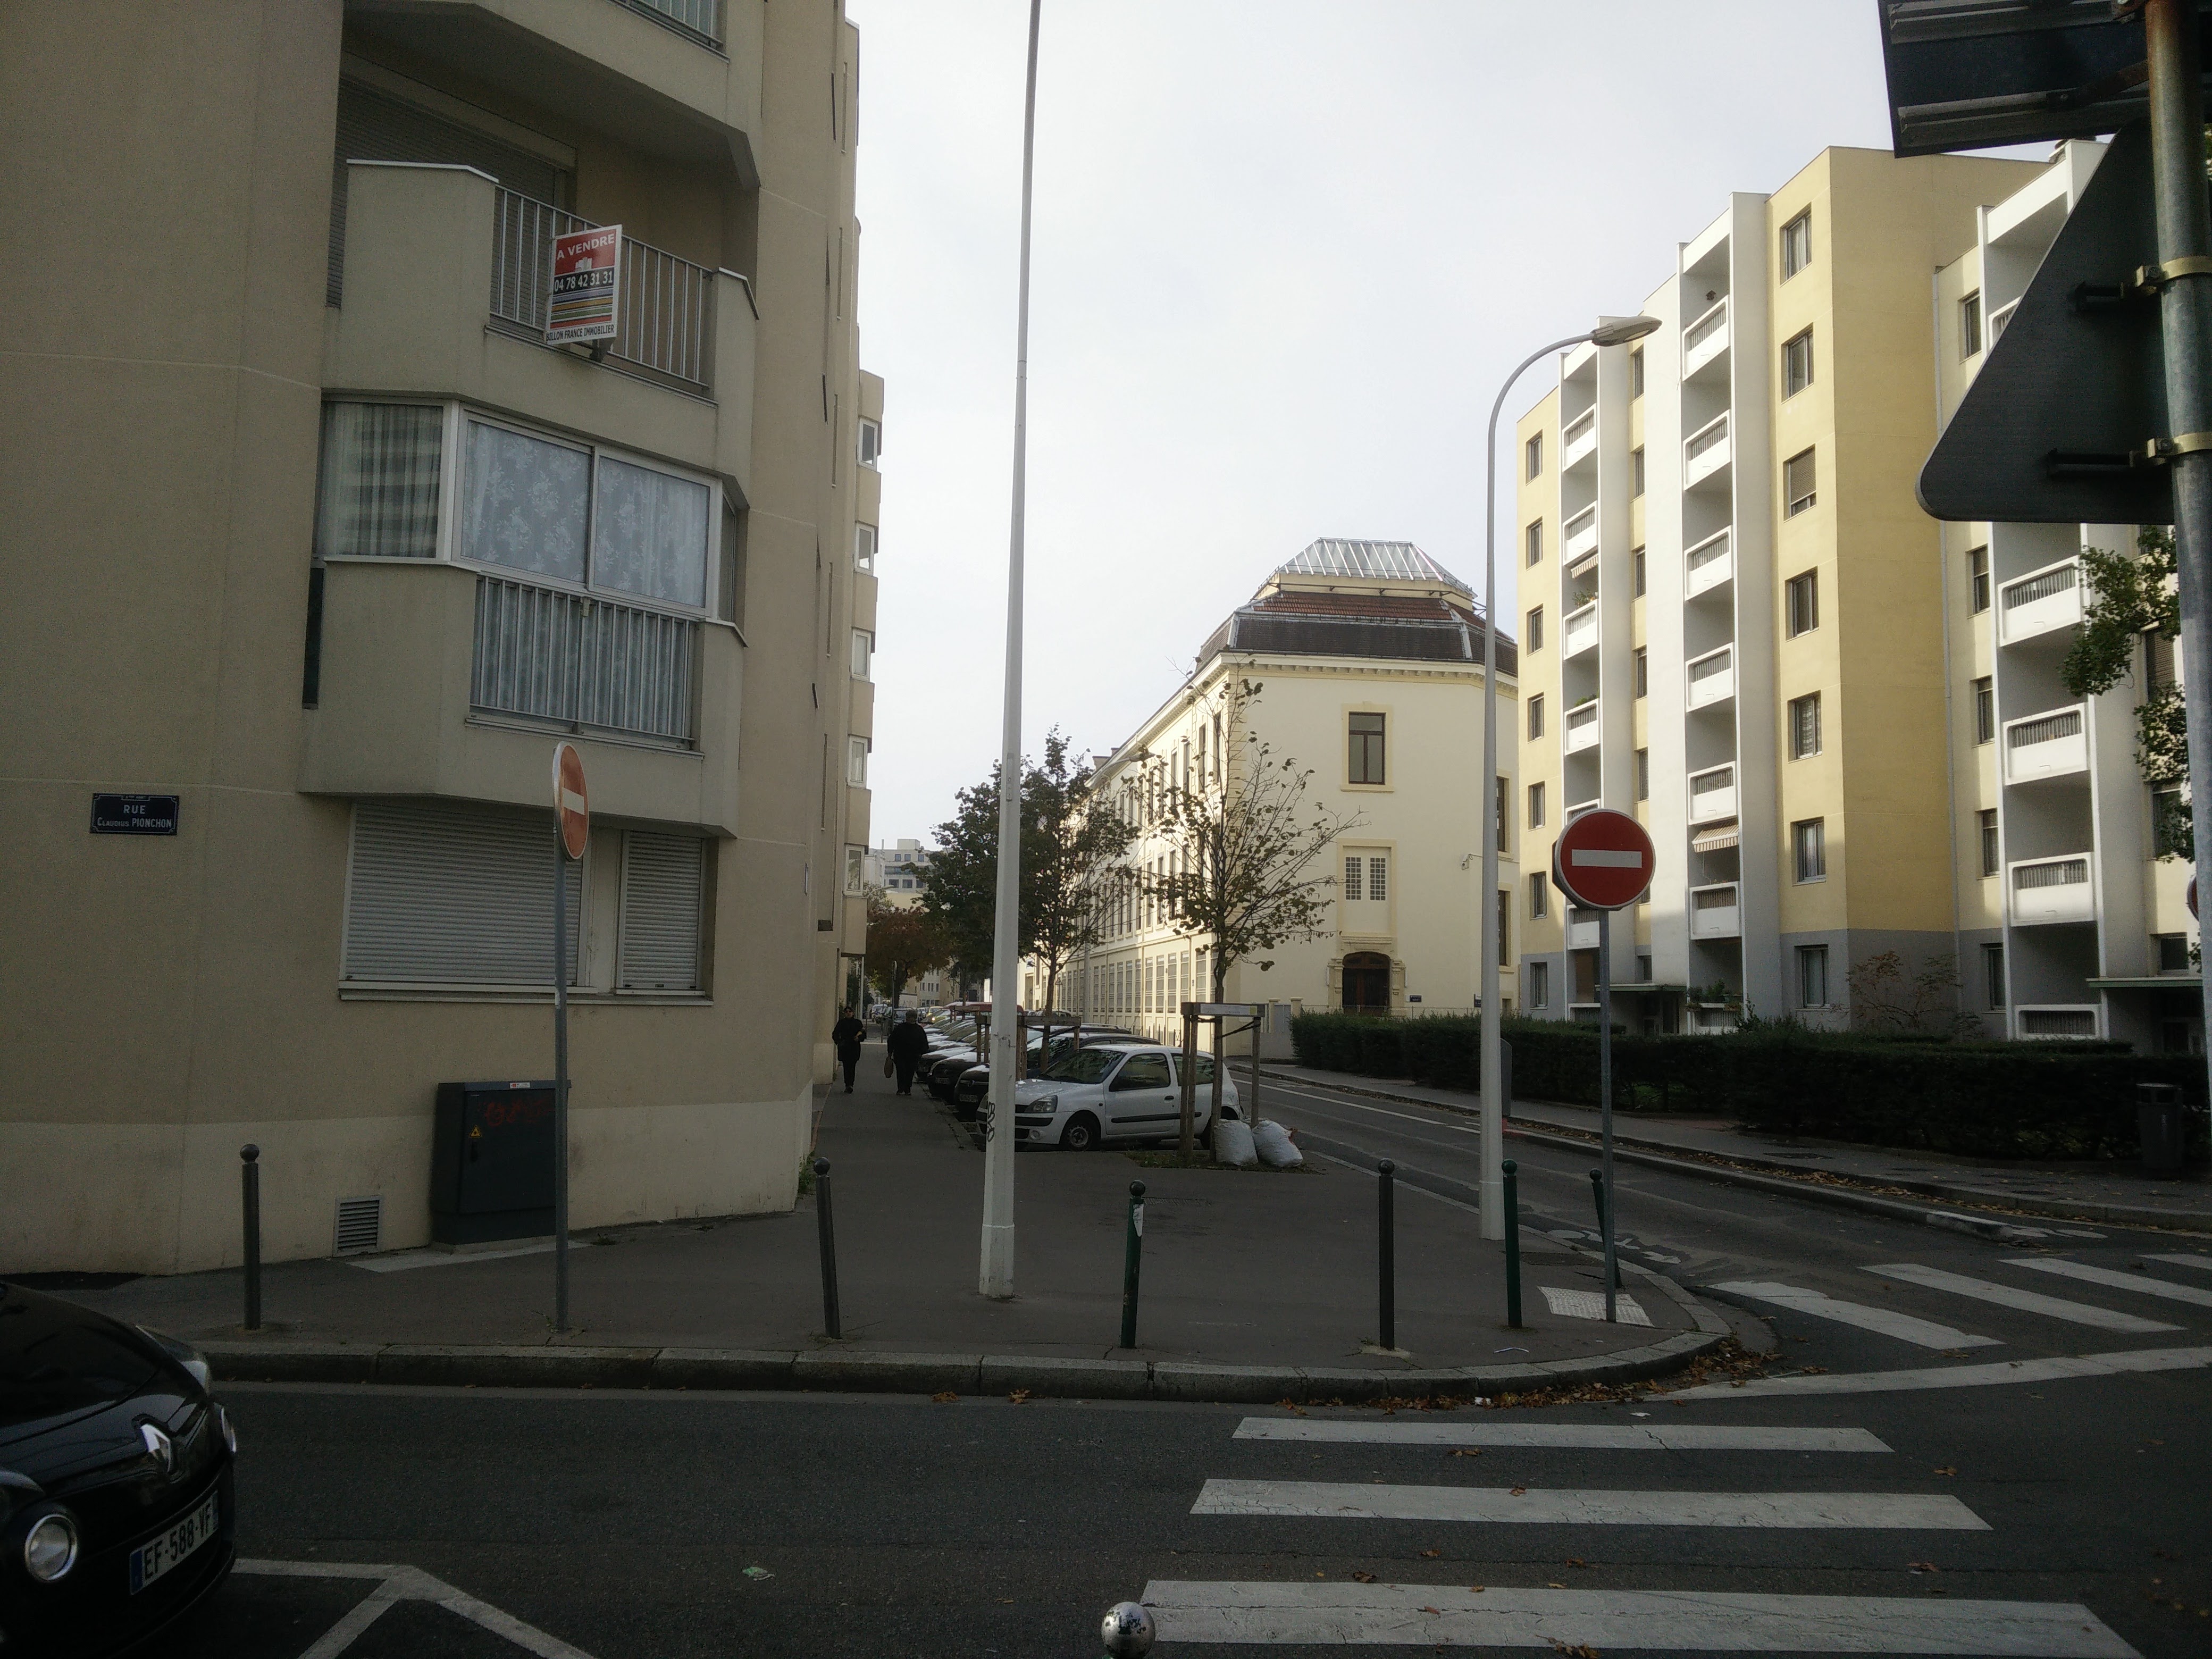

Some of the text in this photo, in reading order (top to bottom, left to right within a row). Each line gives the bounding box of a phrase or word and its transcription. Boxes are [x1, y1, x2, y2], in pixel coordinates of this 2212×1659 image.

[557, 234, 615, 260] A VENDRE
[554, 270, 613, 292] 04 78 42 31 31
[546, 324, 614, 341] BILLON FRANCE IMMOBILIER
[123, 805, 146, 814] RUE
[132, 818, 172, 828] PIONCHON
